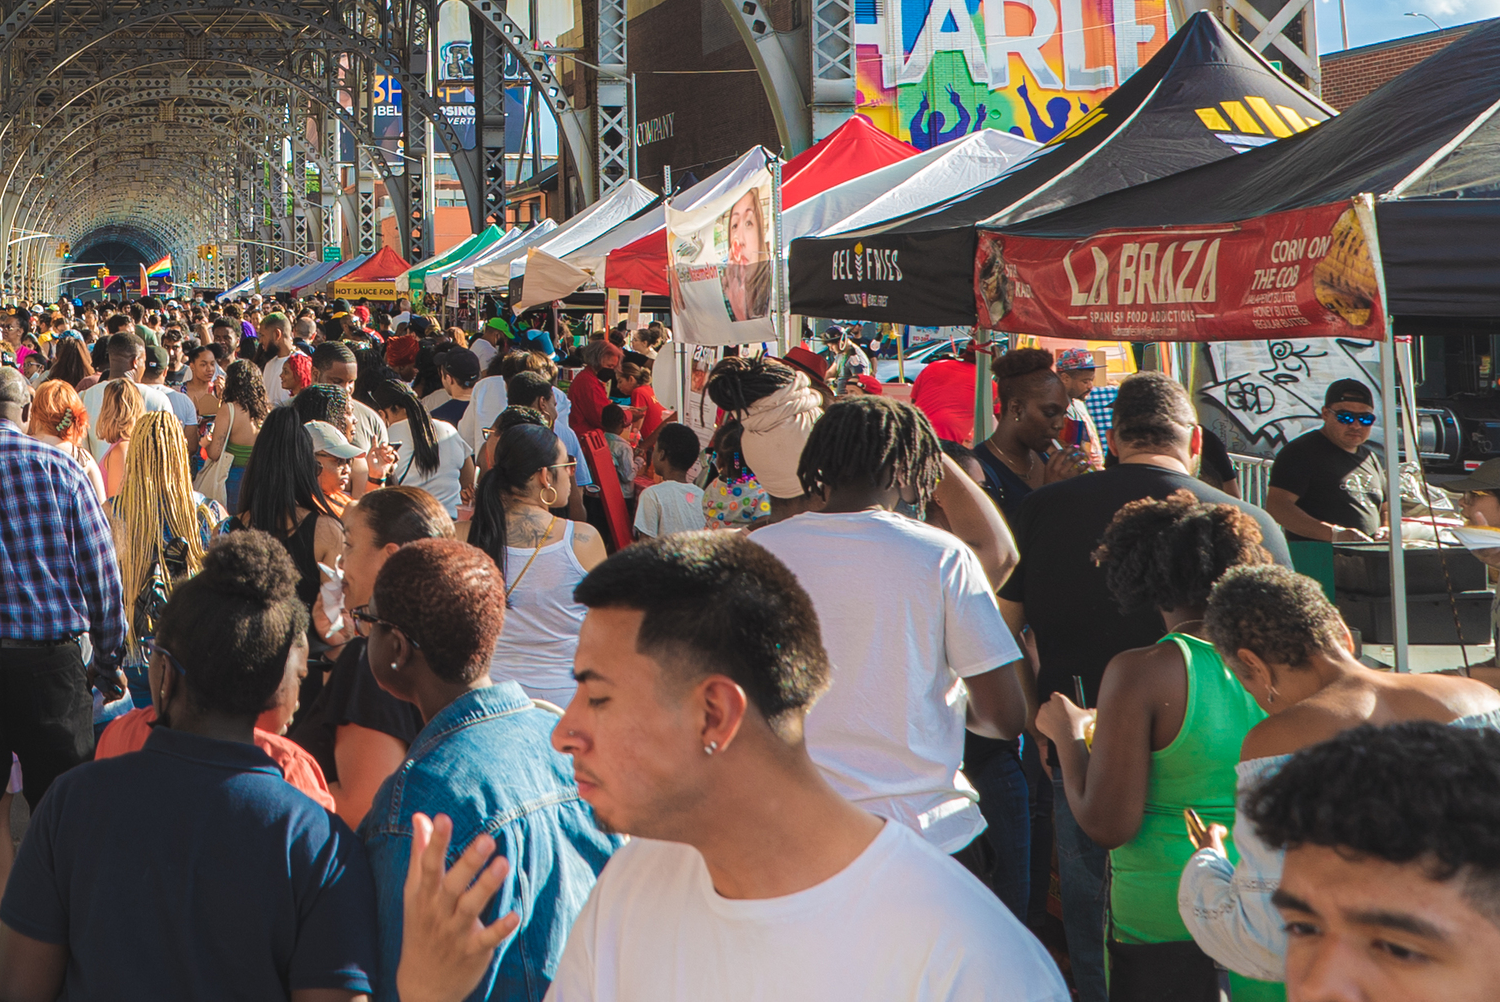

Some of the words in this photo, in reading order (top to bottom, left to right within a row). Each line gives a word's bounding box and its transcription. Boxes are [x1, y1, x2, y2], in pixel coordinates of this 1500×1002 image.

[636, 112, 675, 147] COMPANY
[1271, 237, 1307, 264] CORN
[1307, 235, 1332, 260] ON
[832, 249, 853, 280] BEL
[866, 247, 903, 282] FRIES
[1063, 246, 1109, 306] LA
[1117, 237, 1222, 305] BRAZA
[1251, 268, 1277, 290] THE
[1276, 265, 1300, 288] COB
[1089, 311, 1124, 323] SPANISH
[1126, 311, 1148, 323] FOOD
[1150, 310, 1196, 323] ADDICTIONS
[1252, 306, 1274, 318] HONEY
[1274, 305, 1302, 317] BUTTER
[1252, 319, 1283, 330] REGULAR
[1282, 317, 1312, 329] BUTTER
